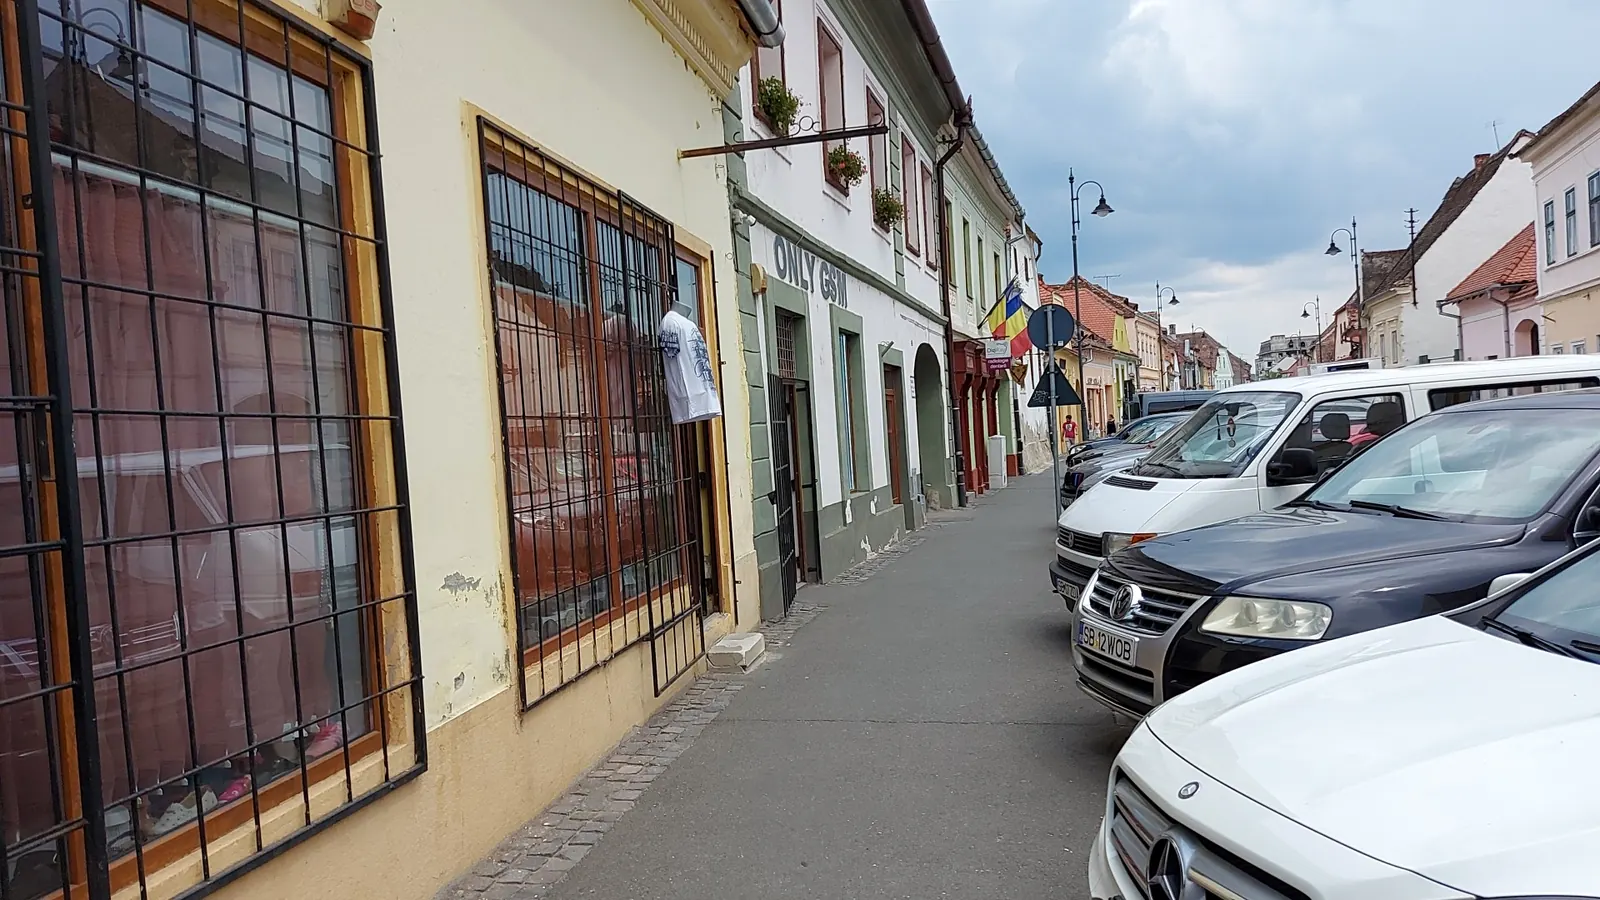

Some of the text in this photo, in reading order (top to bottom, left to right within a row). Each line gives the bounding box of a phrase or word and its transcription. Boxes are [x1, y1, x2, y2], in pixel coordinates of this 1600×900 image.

[774, 235, 847, 309] ONLY GSM
[1084, 626, 1095, 647] SB
